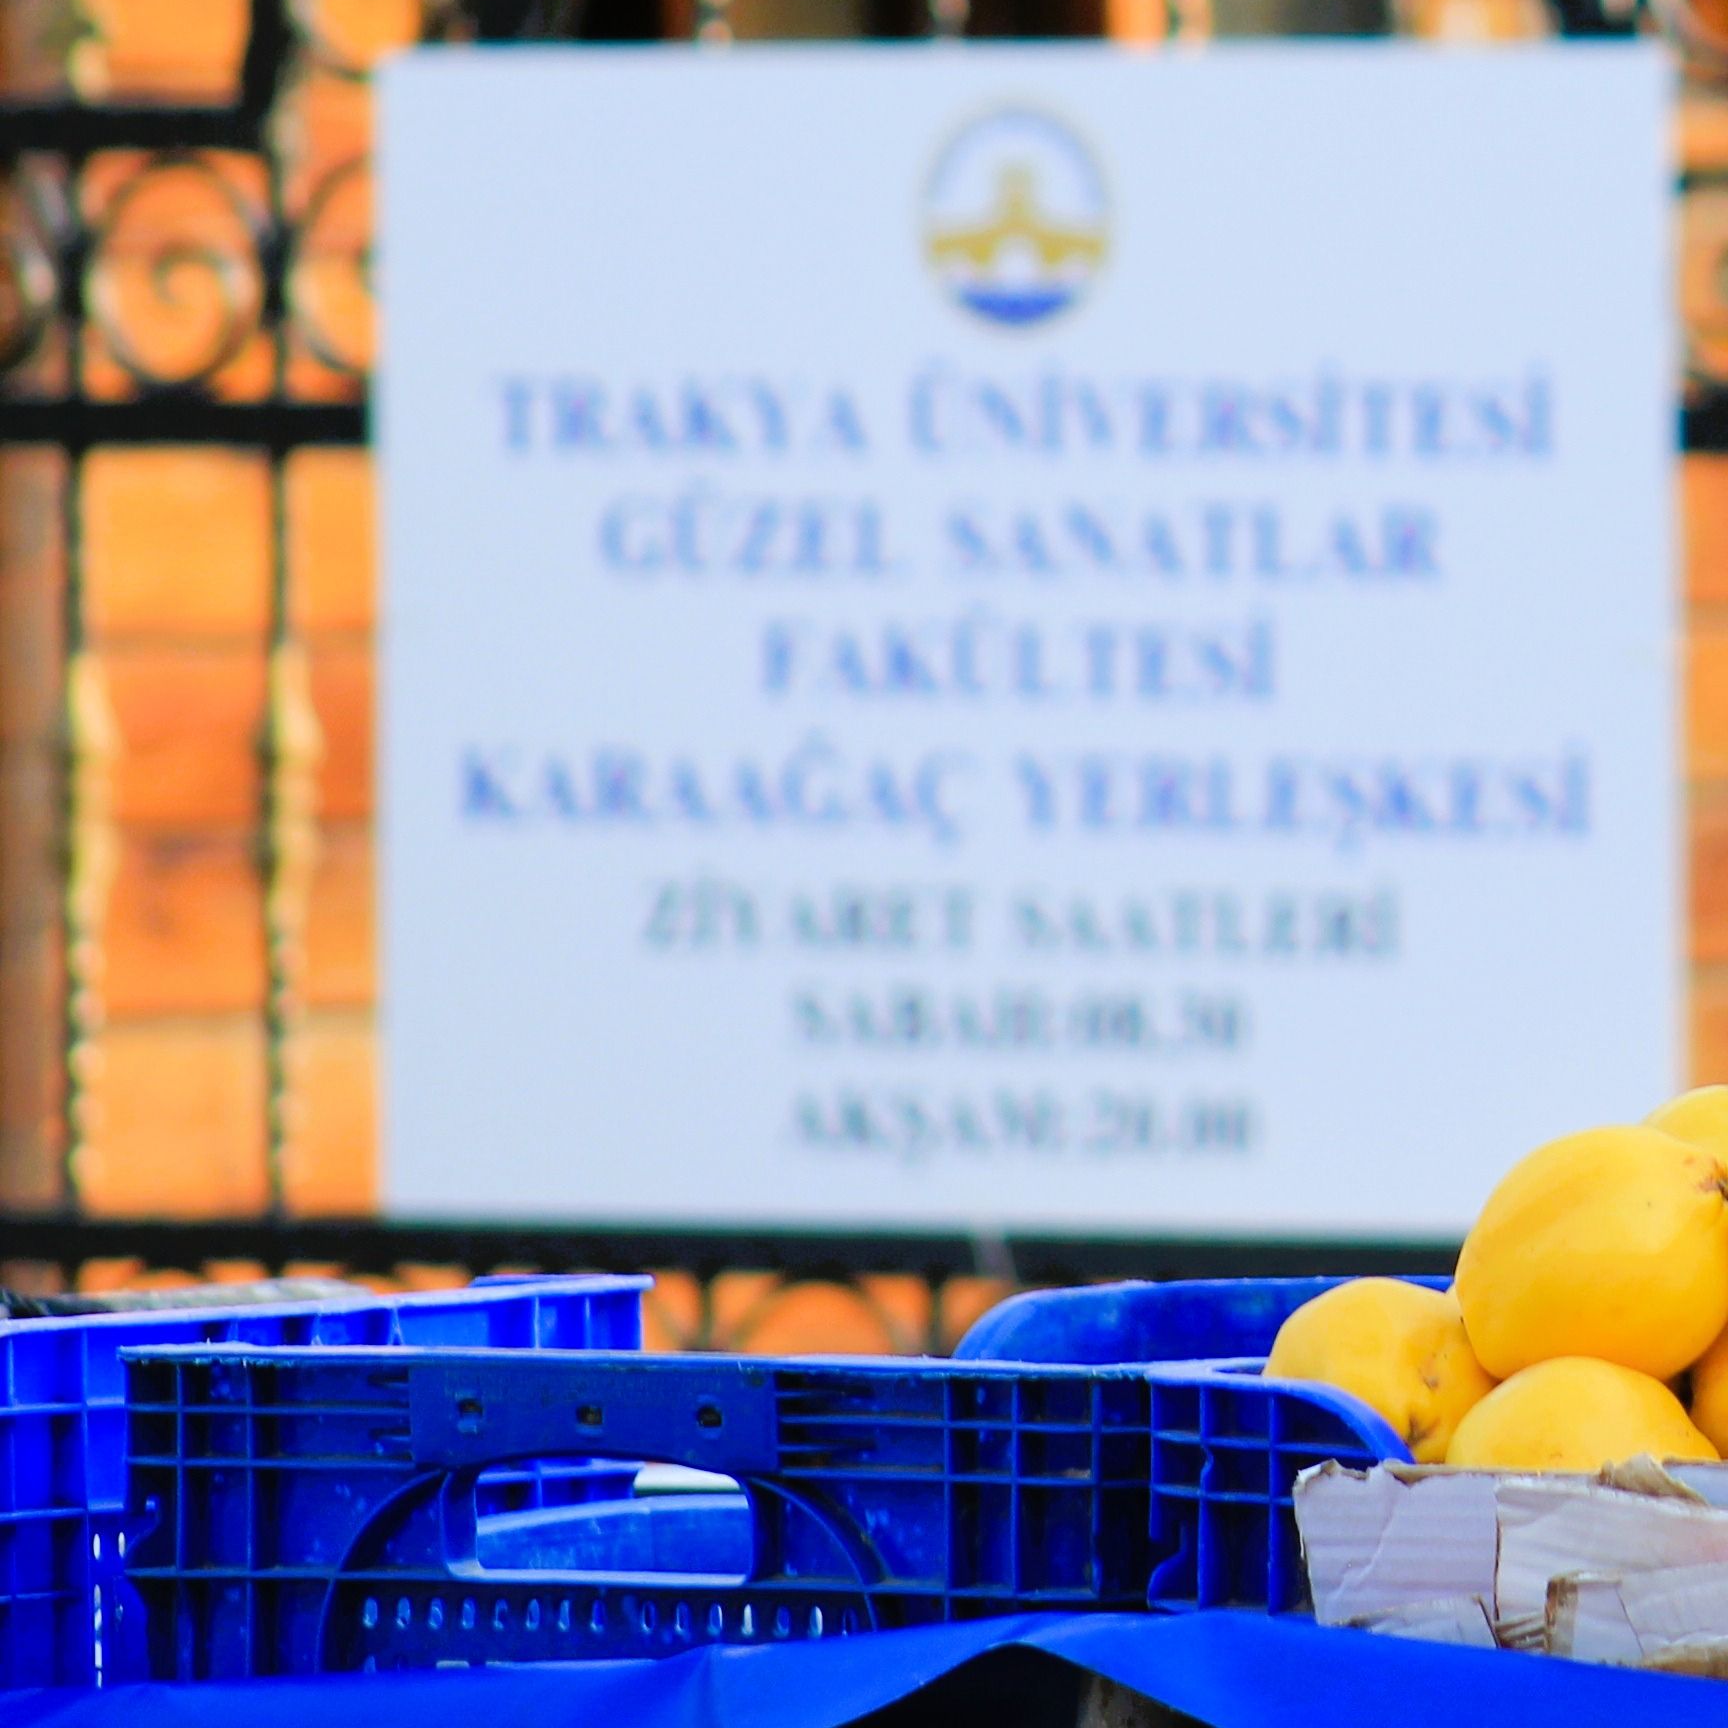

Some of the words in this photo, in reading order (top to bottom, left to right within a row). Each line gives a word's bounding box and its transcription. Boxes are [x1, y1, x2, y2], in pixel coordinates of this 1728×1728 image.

[494, 370, 872, 460] TRAKYA
[905, 358, 1556, 460] ÜNİVERSİTESİ
[596, 477, 908, 582] GÜZEL
[943, 498, 1444, 584] SANATLAR
[757, 600, 1278, 703] FAKÜLTESİ
[456, 728, 980, 852] KARAAĞAÇ
[1010, 738, 1592, 858] YERLEŞKESİ
